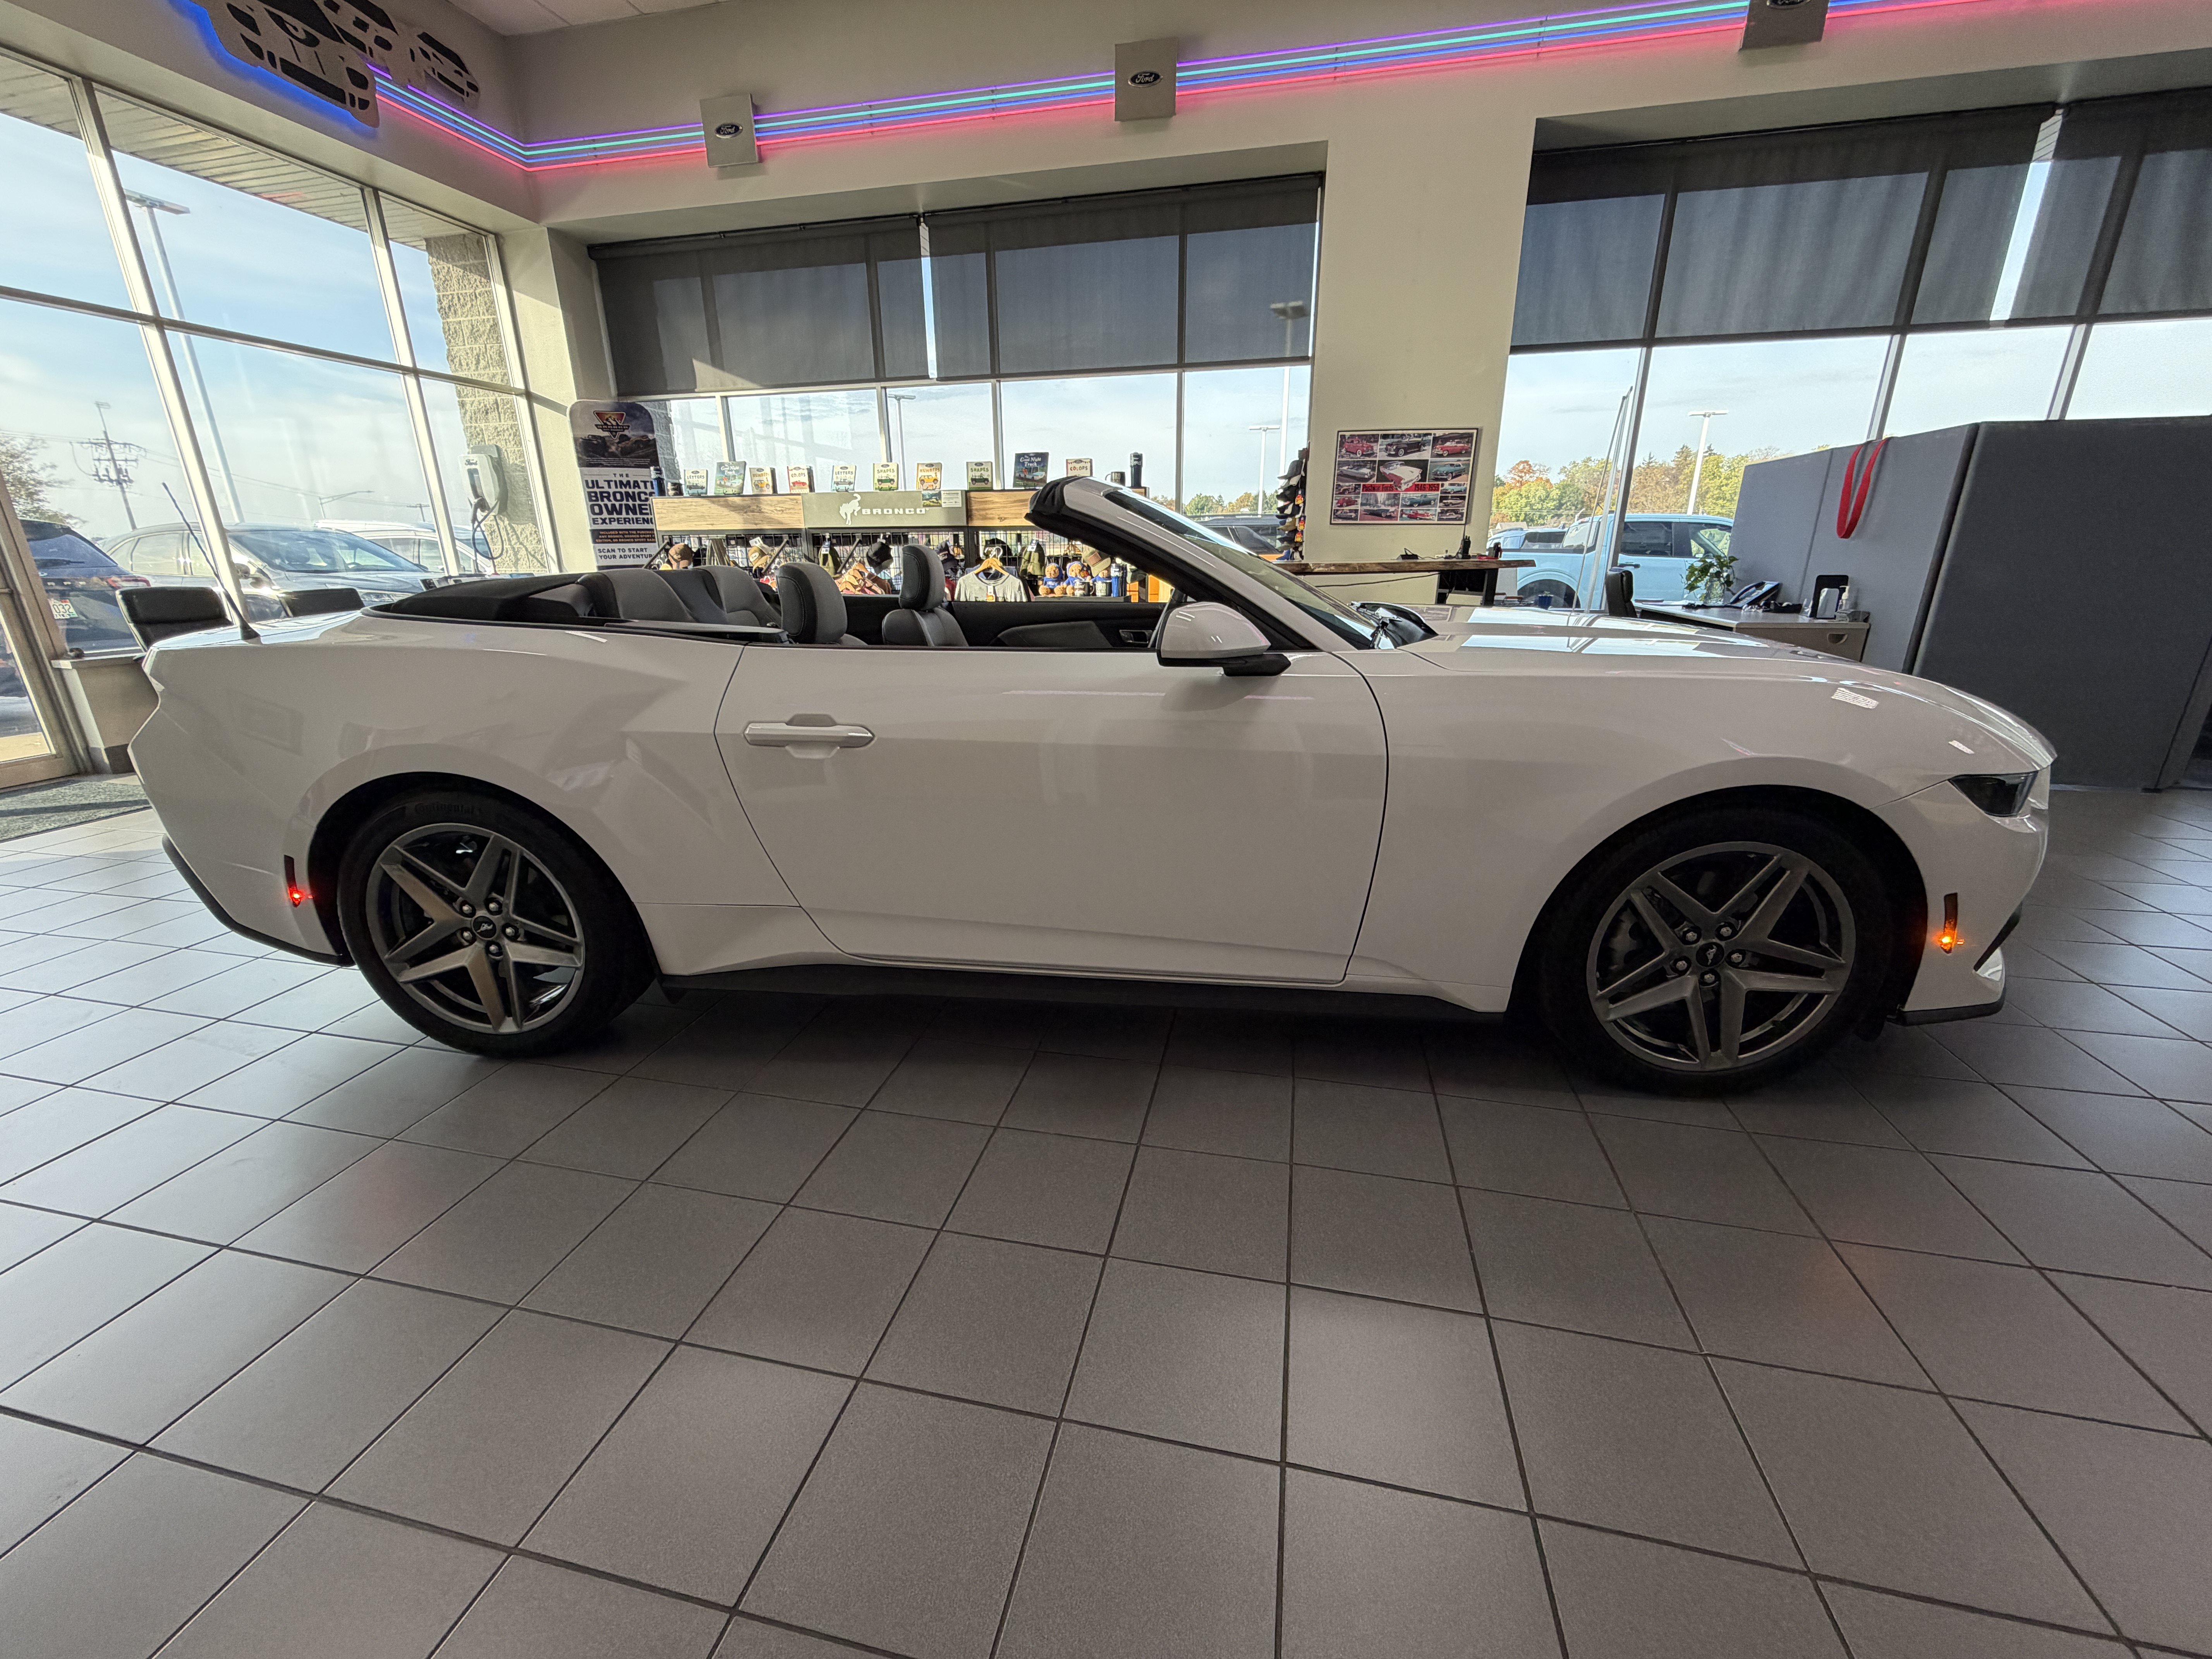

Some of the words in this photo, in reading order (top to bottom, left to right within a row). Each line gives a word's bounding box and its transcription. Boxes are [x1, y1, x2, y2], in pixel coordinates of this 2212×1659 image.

[1135, 73, 1154, 83] Ford
[720, 125, 735, 134] Ford
[52, 604, 74, 614] 032
[415, 803, 474, 814] Continental
